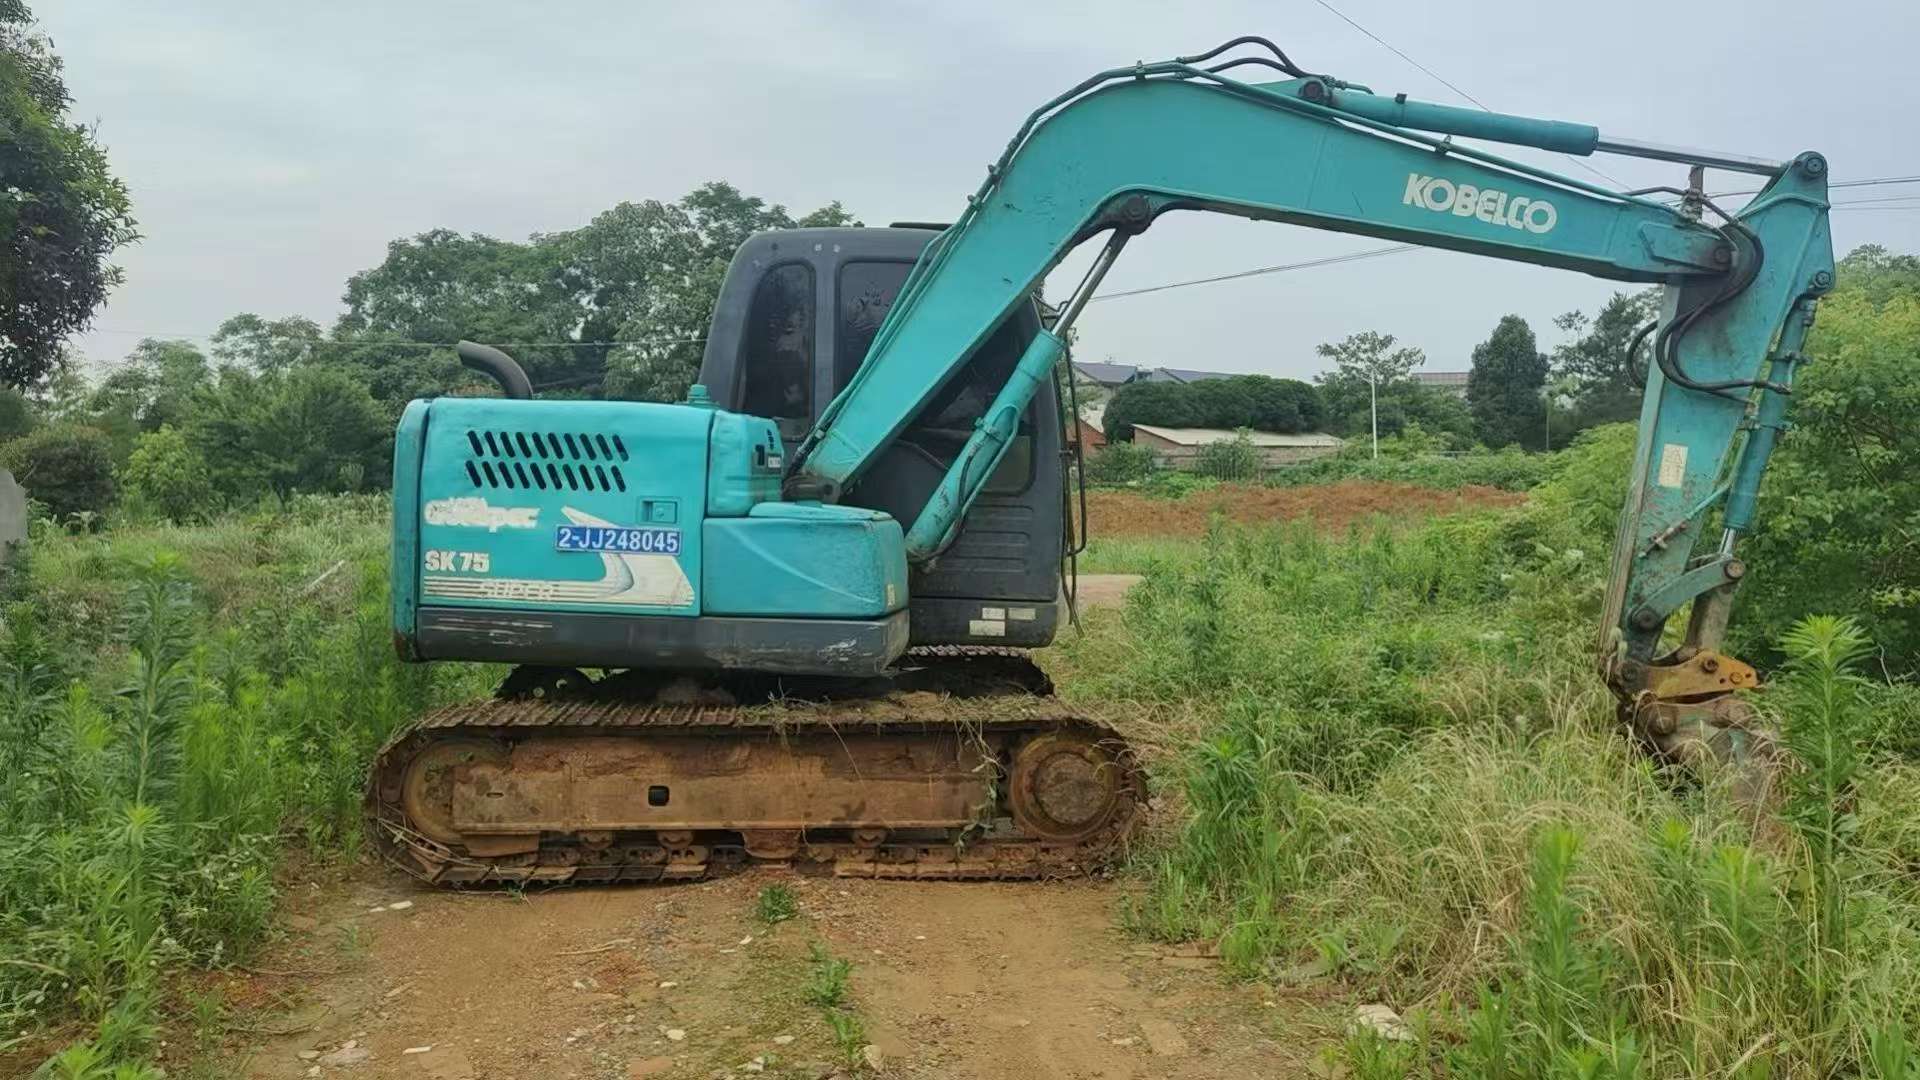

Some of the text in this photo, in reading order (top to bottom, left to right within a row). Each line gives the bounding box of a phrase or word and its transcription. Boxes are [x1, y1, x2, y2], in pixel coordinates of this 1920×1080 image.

[1403, 173, 1557, 233] KOBELCO
[558, 528, 678, 551] 2-JJ248045
[425, 550, 490, 572] SK 75
